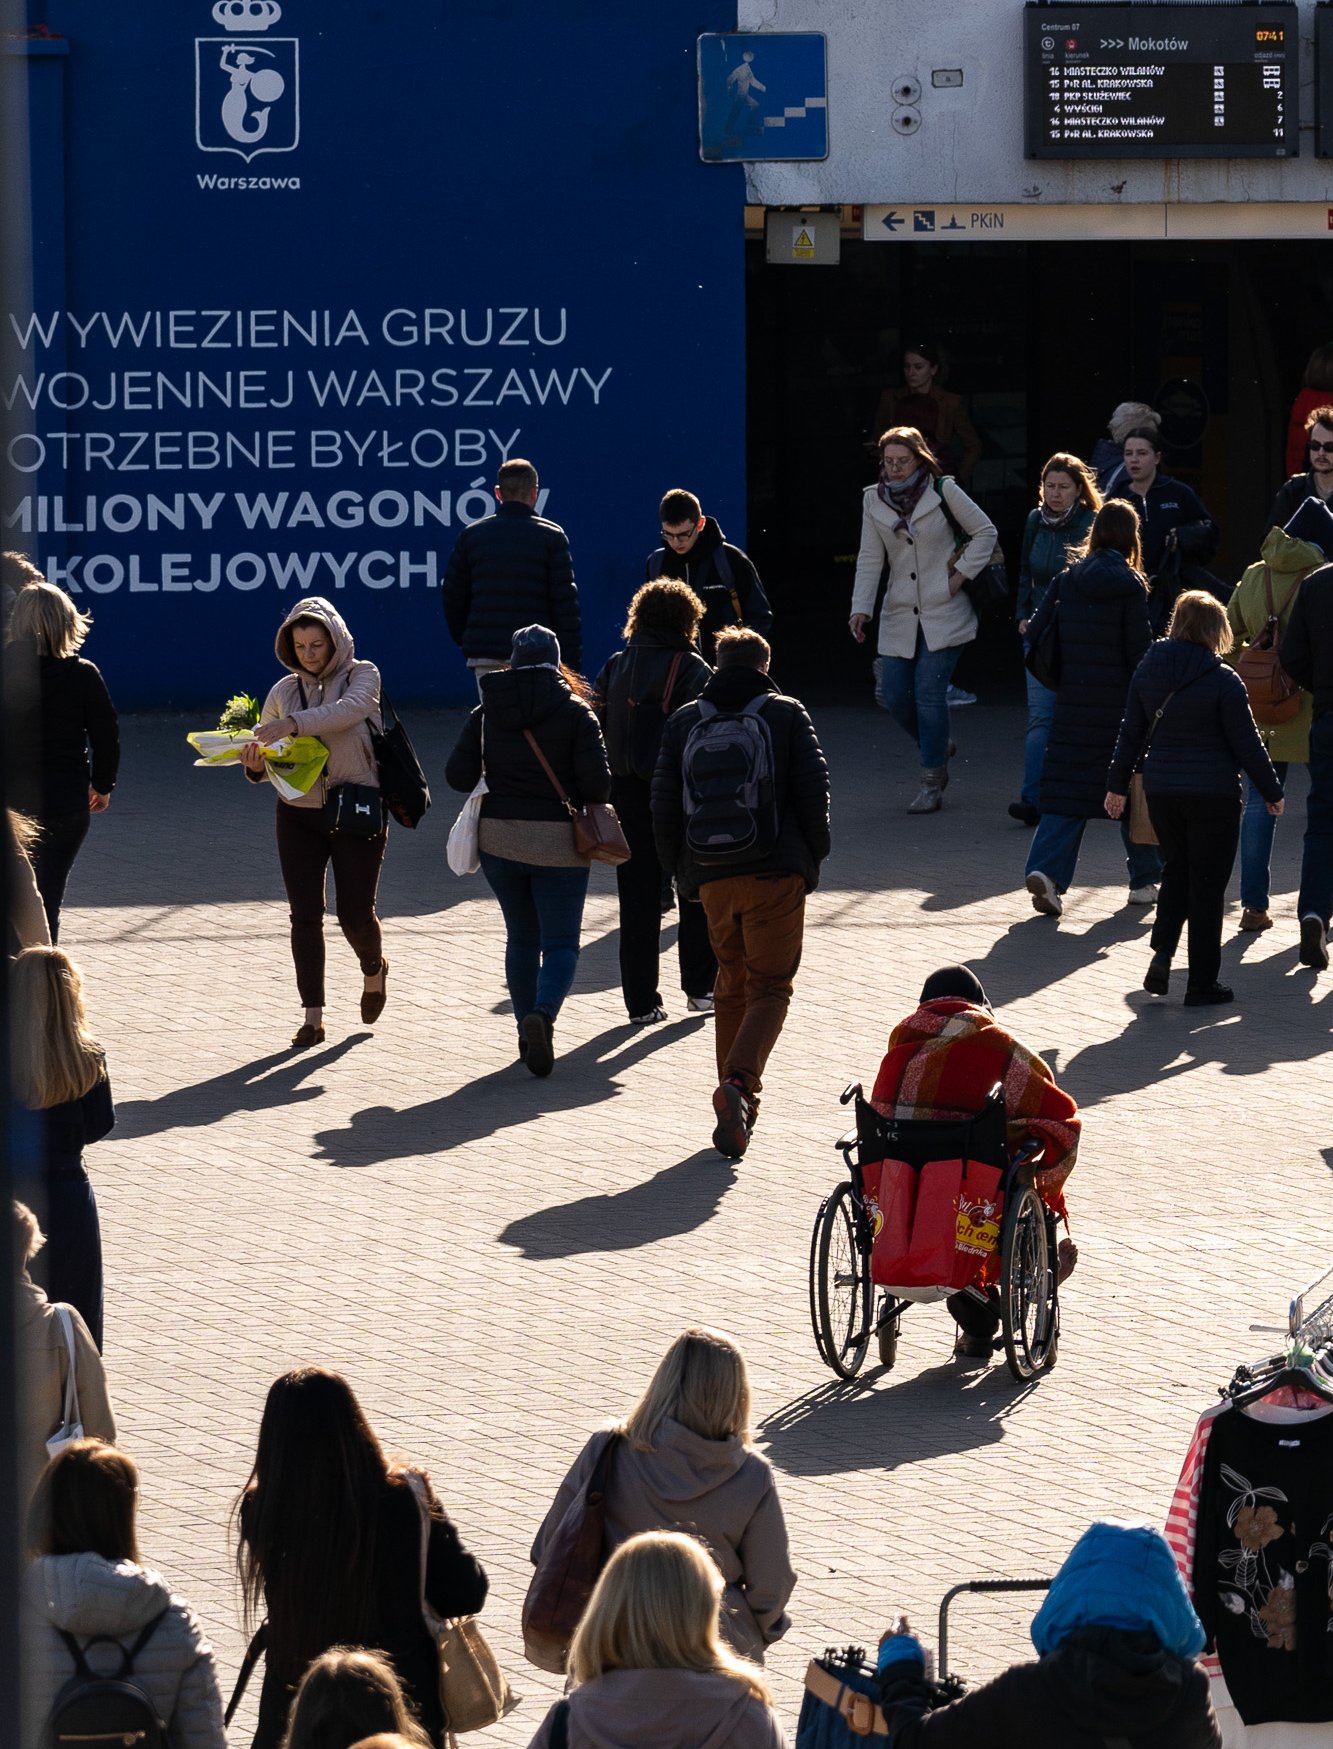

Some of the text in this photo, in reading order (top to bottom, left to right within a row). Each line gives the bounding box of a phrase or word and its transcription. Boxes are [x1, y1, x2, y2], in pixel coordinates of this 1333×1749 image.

[1041, 23, 1070, 31] Centrum
[1128, 37, 1188, 52] Mokotów
[1050, 66, 1060, 76] 16
[1064, 66, 1118, 76] MIASTECZKO
[1050, 79, 1060, 88] 15
[1097, 79, 1153, 88] KRAKOWSKA
[1064, 91, 1080, 100] PKP
[1278, 91, 1283, 100] 2
[1064, 116, 1118, 126] MIASTECZKO
[1278, 116, 1283, 126] 7
[1098, 128, 1154, 138] KRAKOWSKA
[197, 174, 300, 189] Warszawa
[970, 212, 1005, 230] PKiN
[8, 308, 569, 349] WYWIEZIENIA GRUZU
[308, 367, 612, 408] WARSZAWY
[310, 428, 521, 469] BYŁOBY
